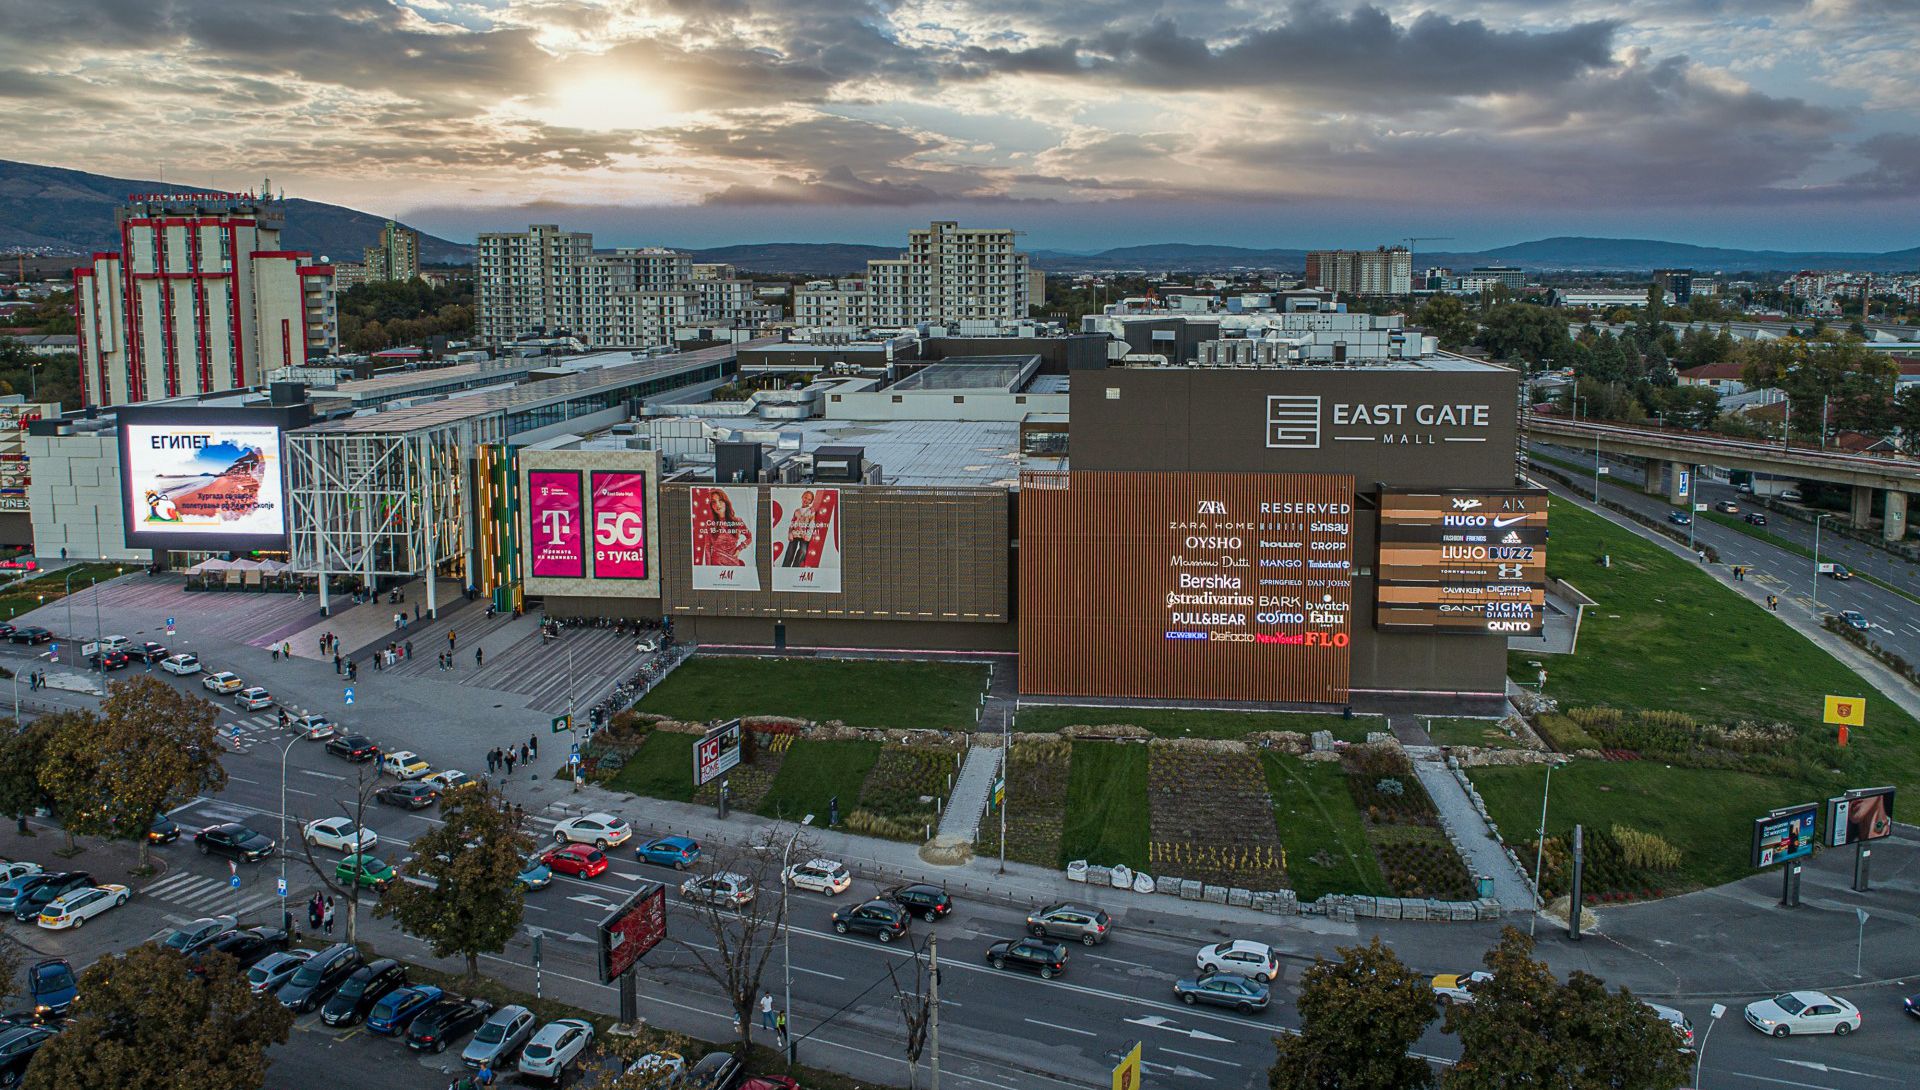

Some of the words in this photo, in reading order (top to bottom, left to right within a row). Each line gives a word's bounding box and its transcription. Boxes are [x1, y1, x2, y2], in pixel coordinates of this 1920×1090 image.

[175, 192, 257, 200] CONTINENTAL
[1333, 404, 1408, 425] EAST
[1416, 404, 1489, 426] GATE
[151, 435, 211, 449] ЕГИПЕТ
[1383, 434, 1435, 444] MALL
[1198, 501, 1227, 514] ZARA
[1261, 502, 1350, 514] RESERVED
[1444, 515, 1487, 526] HUGO
[596, 512, 642, 546] 5G
[1311, 521, 1348, 535] sinsay
[1186, 536, 1241, 549] OYSHO
[1311, 541, 1346, 550] CROPP
[596, 551, 605, 560] е
[608, 548, 643, 564] тука!
[1488, 546, 1533, 560] BUZZ
[1170, 555, 1218, 567] Massimo
[1221, 556, 1250, 568] Dutti
[1260, 559, 1302, 568] MANGO
[1308, 560, 1341, 568] Timberland
[1180, 573, 1241, 589] Bershka
[1307, 579, 1325, 587] DAN
[1327, 579, 1350, 588] JOHN
[1486, 585, 1532, 593] DIOPTRA
[1173, 591, 1254, 606] stradivarius
[1260, 596, 1301, 607] BARK
[1314, 601, 1349, 611] watch
[1439, 604, 1485, 612] GANT
[1487, 602, 1533, 612] SIGMA
[1172, 612, 1246, 625] PULL&BEAR
[1257, 610, 1304, 625] cosmo
[1310, 610, 1344, 624] fabu
[1487, 621, 1531, 631] QUNTO
[1210, 630, 1255, 642] DeFacto
[1305, 631, 1349, 647] FLO
[702, 741, 717, 765] HC
